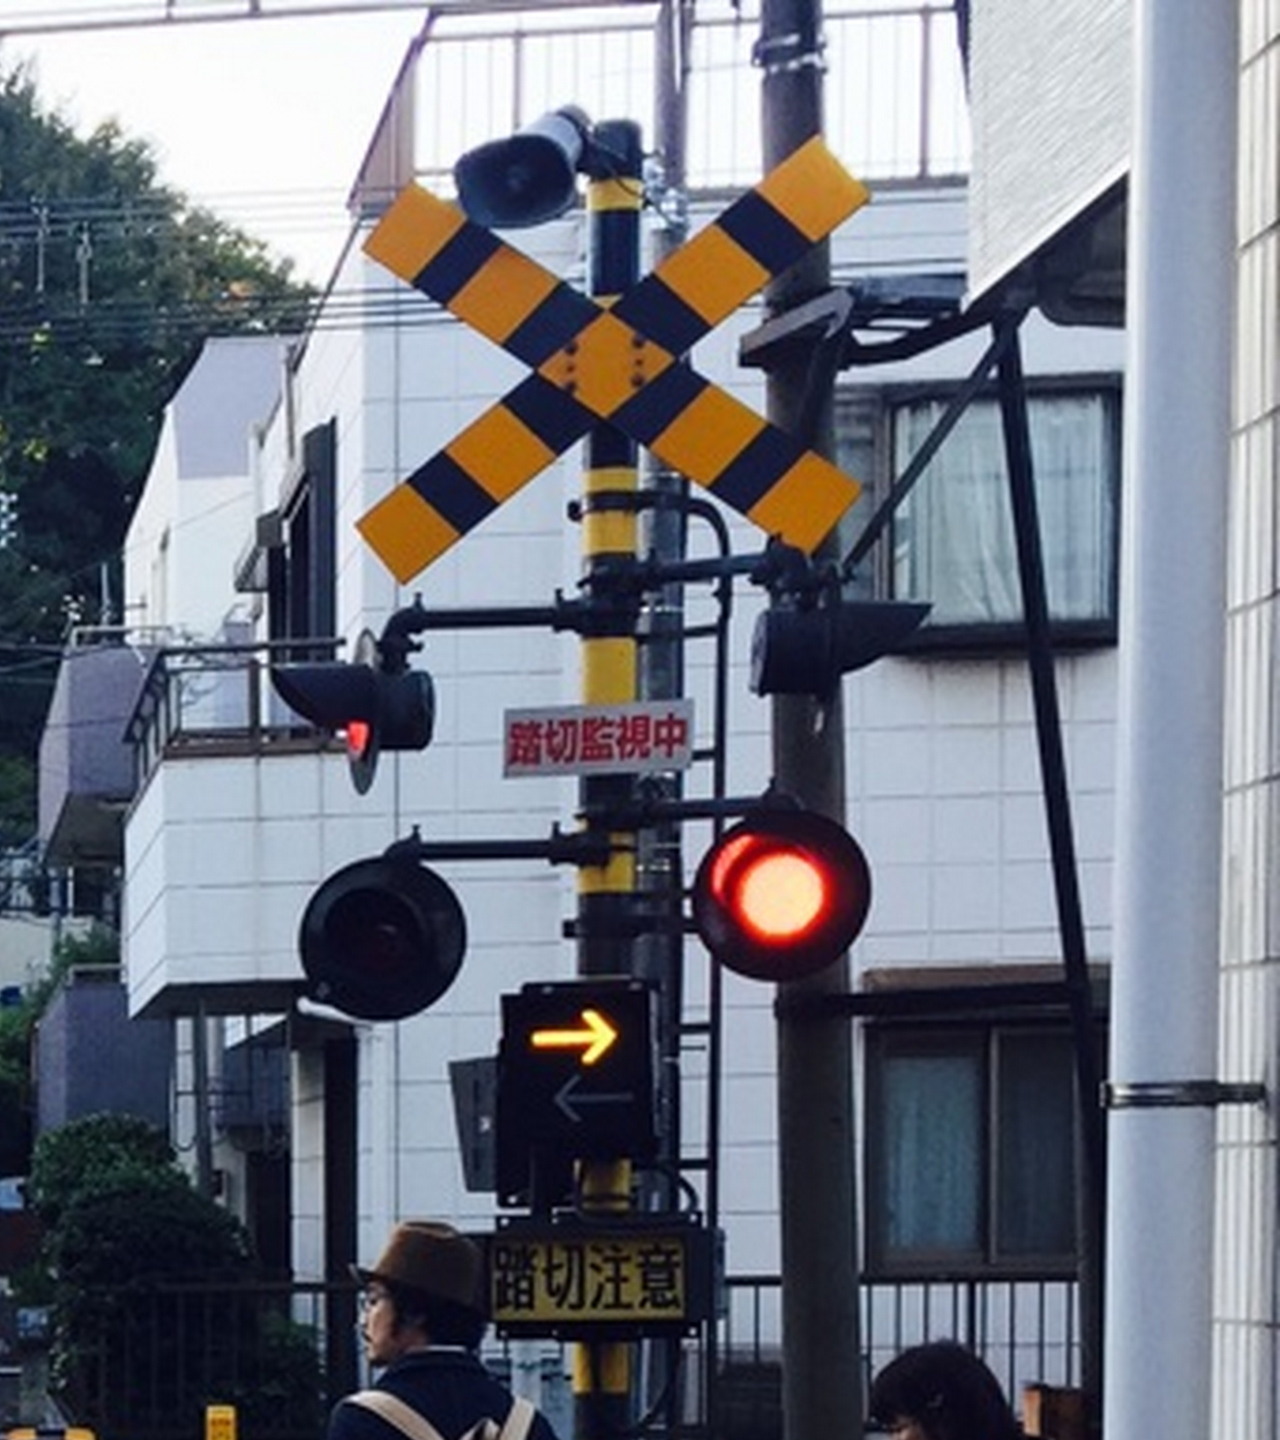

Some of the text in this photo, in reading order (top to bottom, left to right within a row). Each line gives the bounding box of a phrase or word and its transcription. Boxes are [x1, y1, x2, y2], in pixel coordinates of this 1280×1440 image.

[509, 713, 688, 765] 踏切監視中
[495, 1244, 681, 1311] 踏切注意
